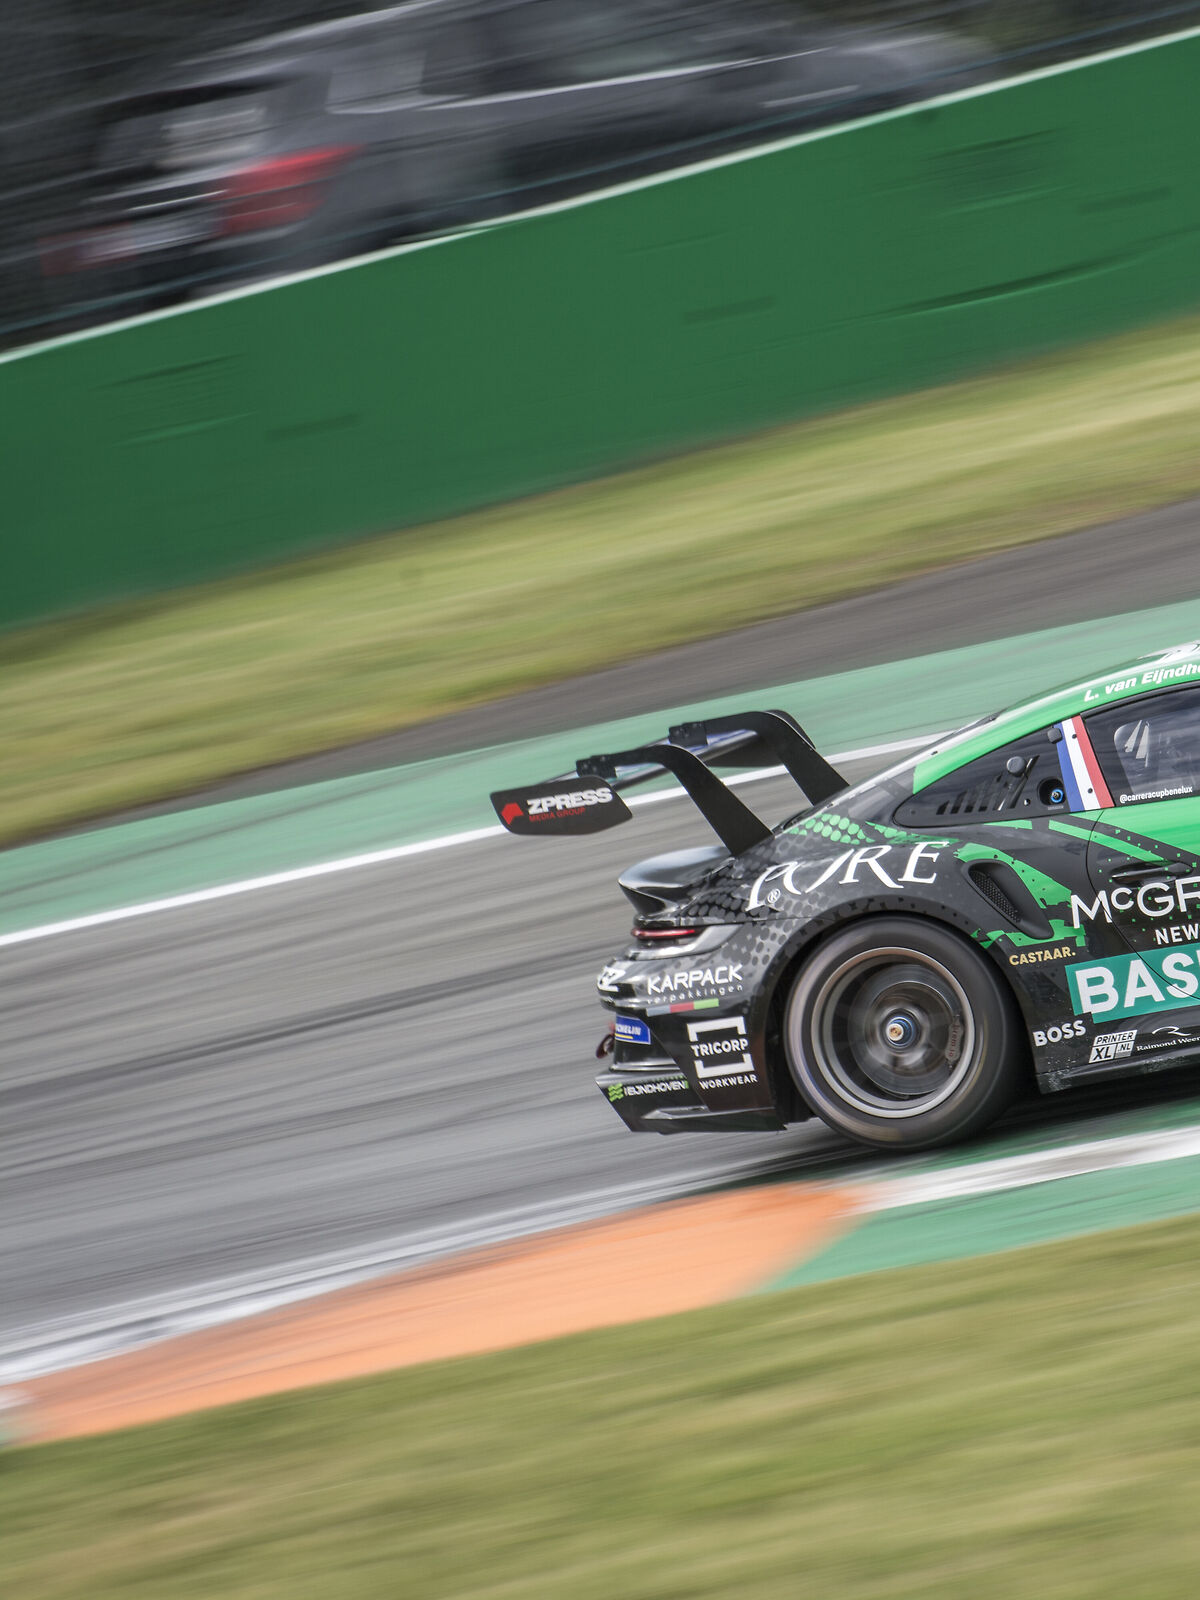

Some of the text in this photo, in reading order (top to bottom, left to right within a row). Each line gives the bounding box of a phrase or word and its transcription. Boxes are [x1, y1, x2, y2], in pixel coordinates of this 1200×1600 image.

[1084, 689, 1099, 702] L.
[1105, 677, 1137, 695] van
[527, 787, 613, 815] ZPRESS
[1119, 786, 1193, 803] @carreracupbenelux
[529, 807, 586, 822] MEDIA GROUP
[1155, 924, 1199, 945] NEW
[647, 964, 743, 995] KARPACK
[1032, 1020, 1086, 1046] BOSS
[1096, 1031, 1135, 1045] PRINTER
[690, 1038, 749, 1057] TRICORP
[1093, 1046, 1115, 1062] XL
[1136, 1038, 1177, 1052] Raimond
[700, 1074, 758, 1090] WORKWEAR
